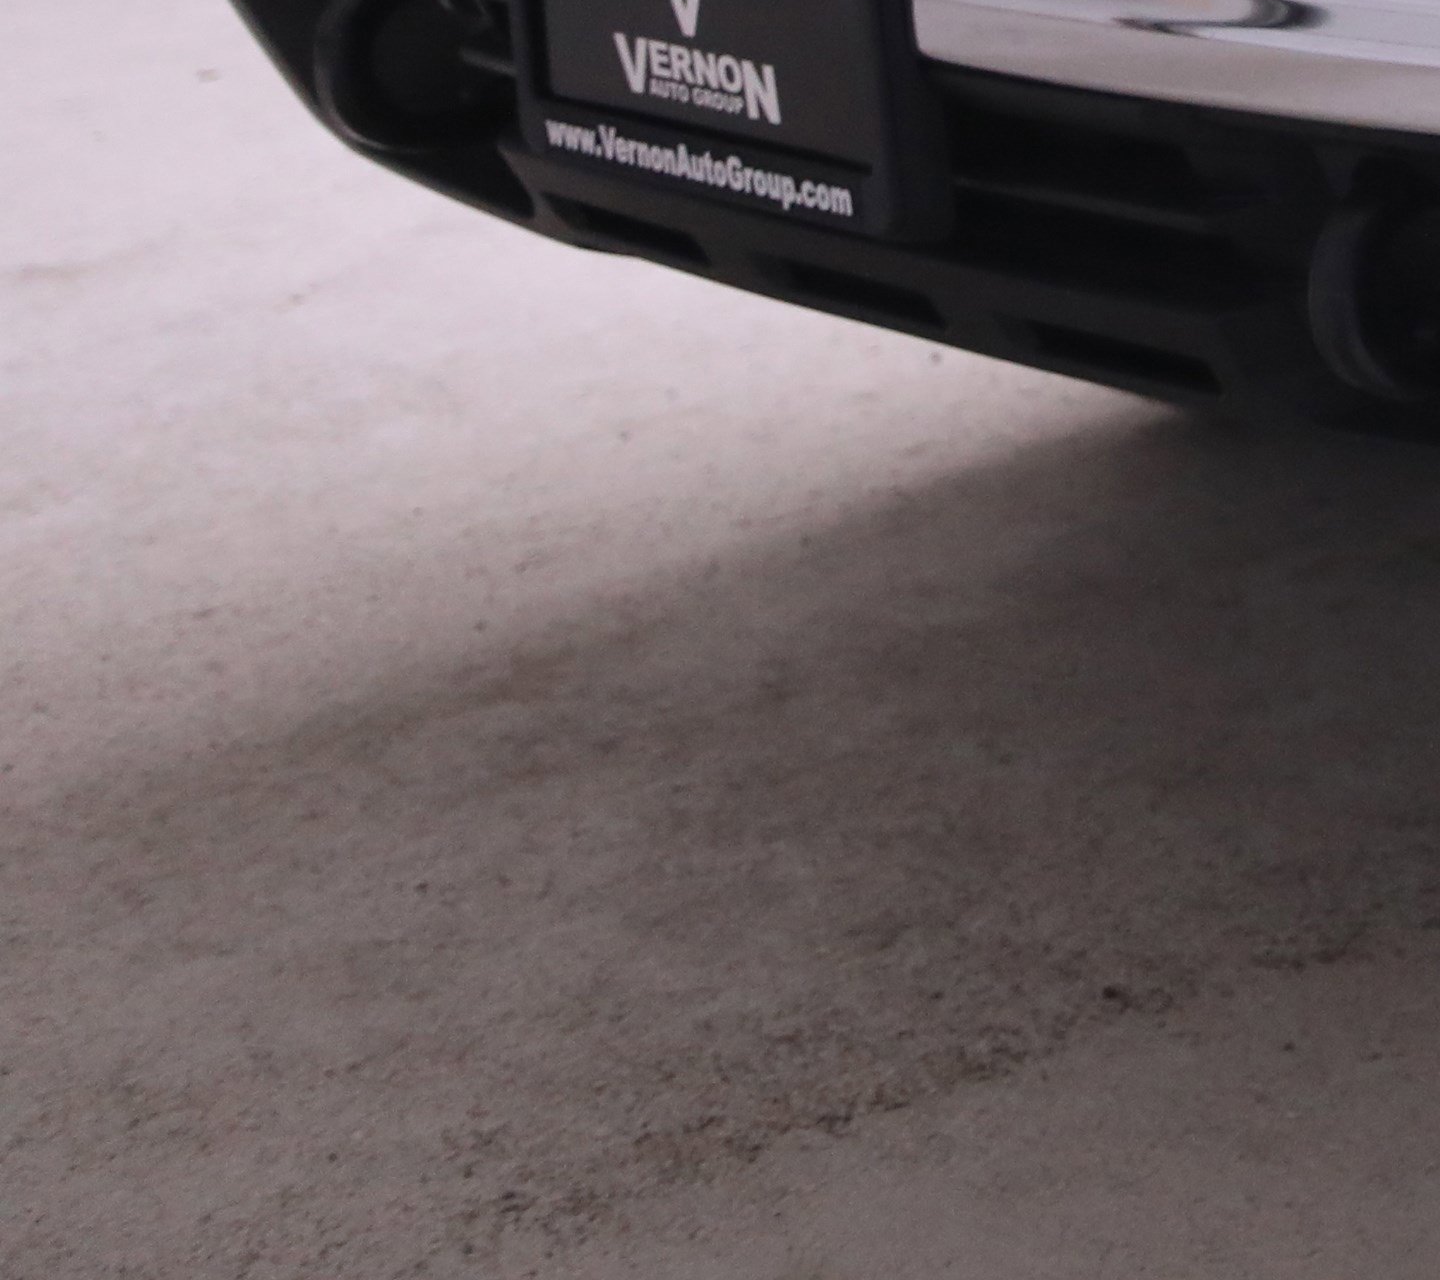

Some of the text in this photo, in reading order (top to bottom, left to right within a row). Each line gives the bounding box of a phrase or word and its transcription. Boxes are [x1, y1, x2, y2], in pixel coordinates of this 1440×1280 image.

[613, 32, 782, 125] VERNON
[648, 83, 745, 116] AUTO GROUP
[546, 120, 854, 216] www.VernonAutoGroup.com
